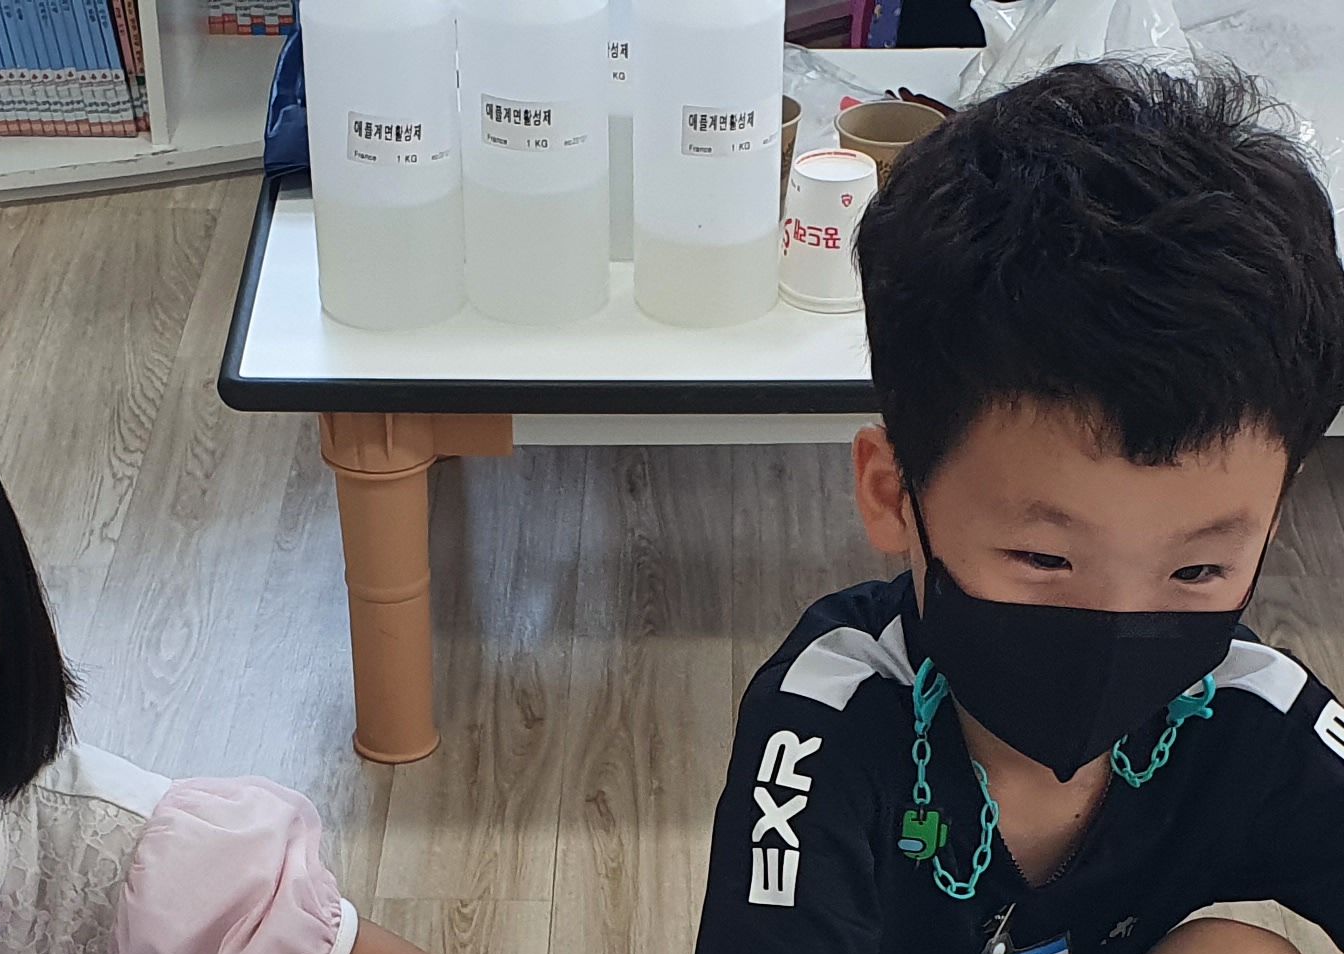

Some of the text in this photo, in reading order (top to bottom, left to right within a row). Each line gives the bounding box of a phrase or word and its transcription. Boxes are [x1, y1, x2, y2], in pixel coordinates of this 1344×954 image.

[607, 42, 628, 58] 성제
[612, 71, 626, 81] KG
[486, 103, 552, 126] 애플계면활성제
[689, 111, 754, 132] 애플계면활성제
[354, 120, 422, 142] 애플계면활성제
[535, 139, 548, 148] KG
[354, 149, 377, 161] France
[404, 154, 418, 163] KG
[748, 729, 823, 907] EXR
